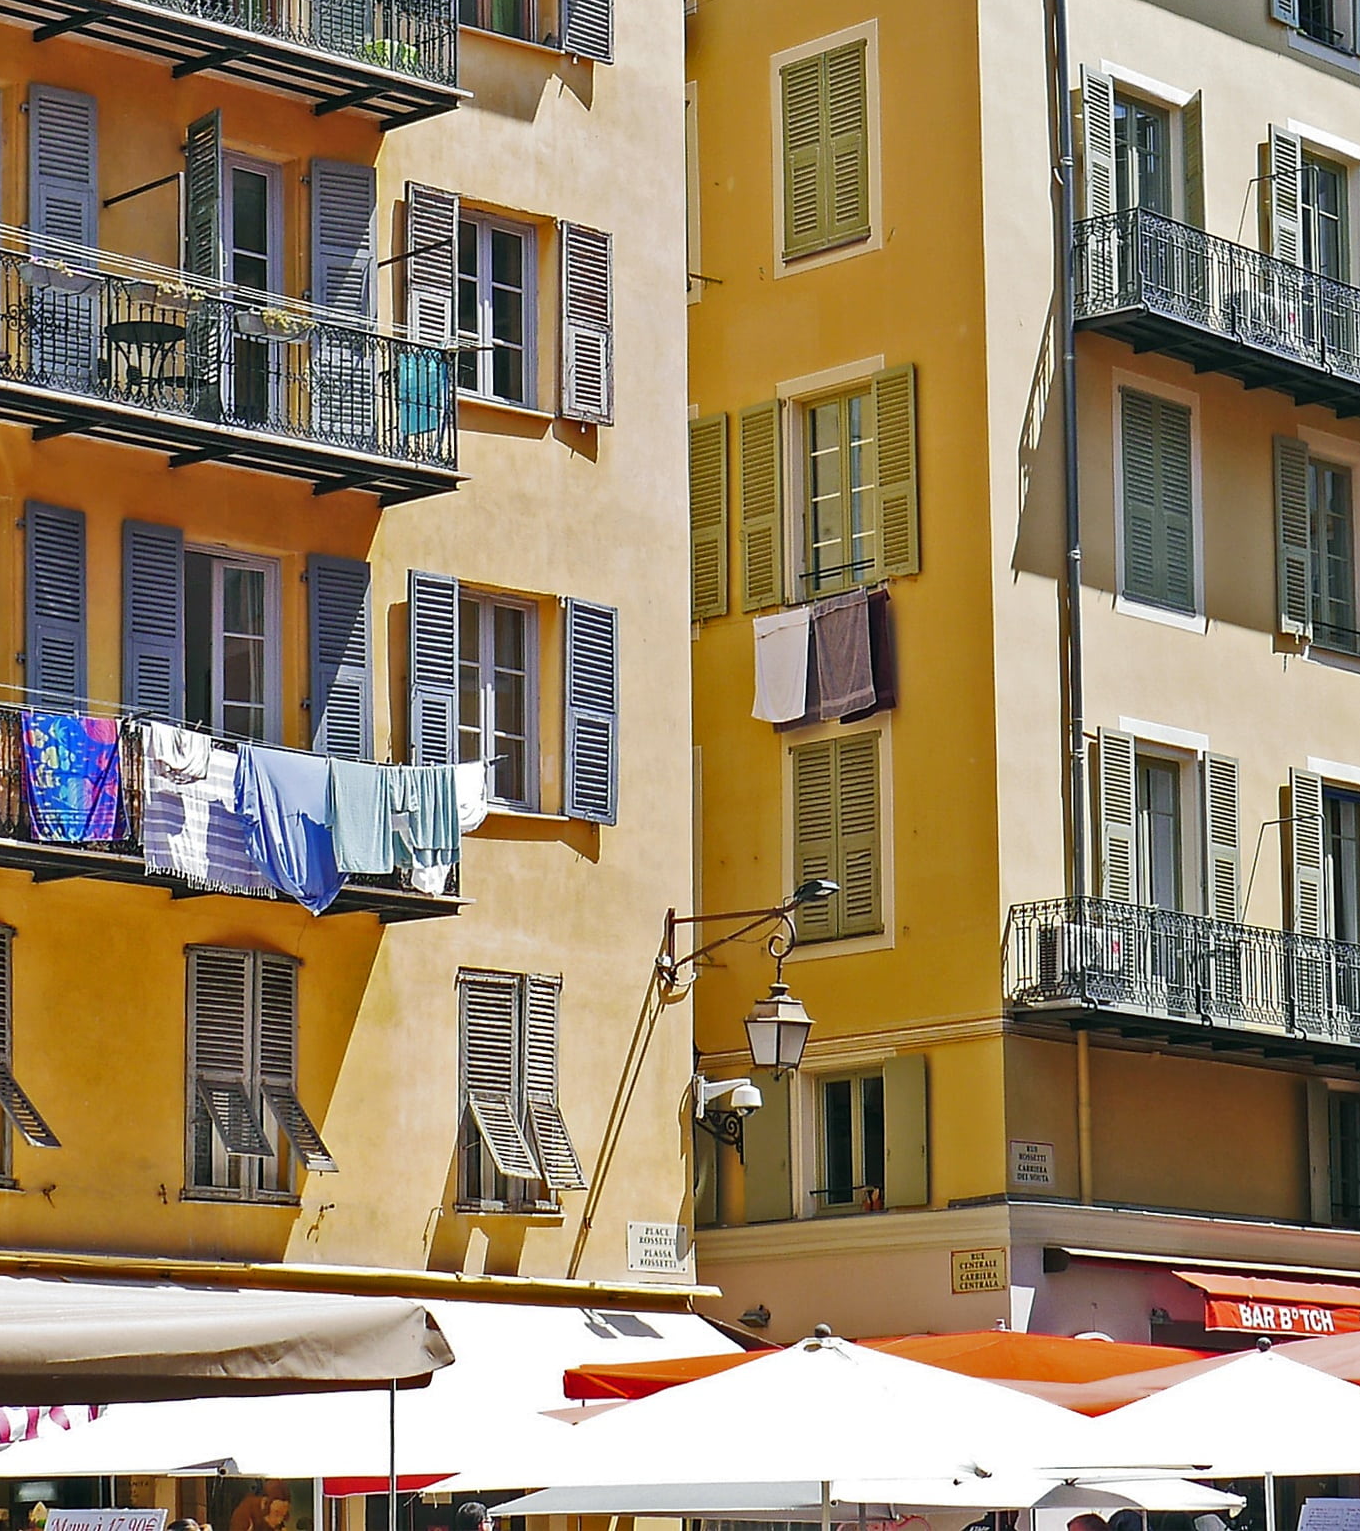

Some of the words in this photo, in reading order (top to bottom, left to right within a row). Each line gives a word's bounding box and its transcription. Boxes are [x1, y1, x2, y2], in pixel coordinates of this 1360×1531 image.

[645, 1228, 669, 1236] PLACE
[639, 1236, 676, 1245] ROSSETTI
[644, 1249, 672, 1258] PLASSA
[640, 1259, 677, 1268] ROSSETTI
[959, 1260, 997, 1269] CENTRALE
[1239, 1304, 1276, 1329] BAR
